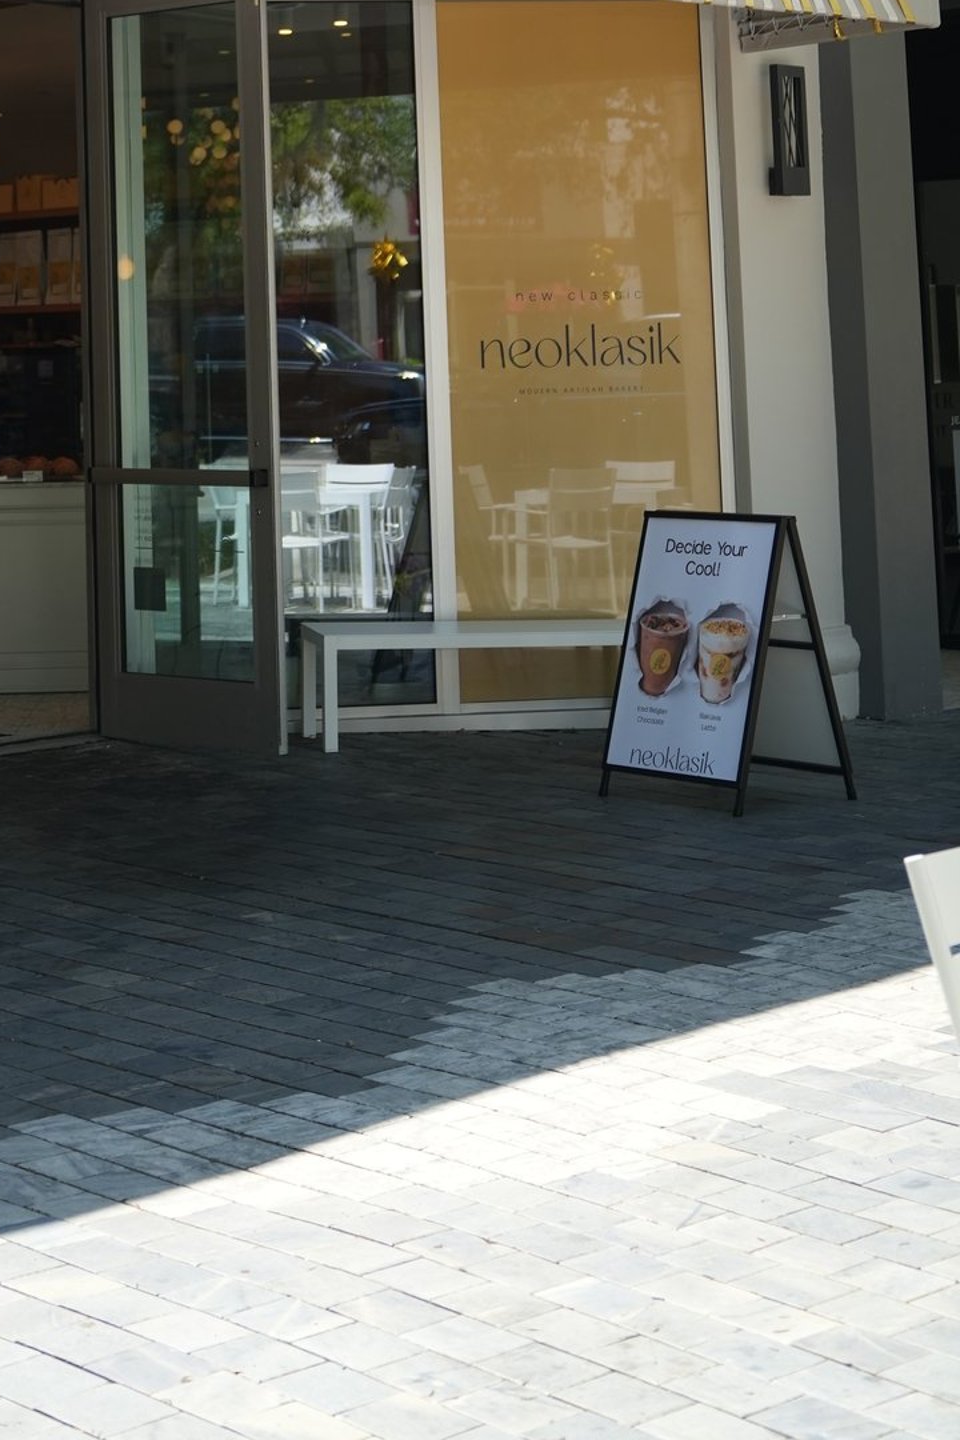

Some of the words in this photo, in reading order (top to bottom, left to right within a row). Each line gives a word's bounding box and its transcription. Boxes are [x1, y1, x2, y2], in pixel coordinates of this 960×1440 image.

[515, 291, 554, 302] new
[480, 322, 681, 369] neoklasik
[665, 538, 713, 556] Decide
[717, 540, 748, 557] Your
[628, 745, 715, 776] neoklasik
